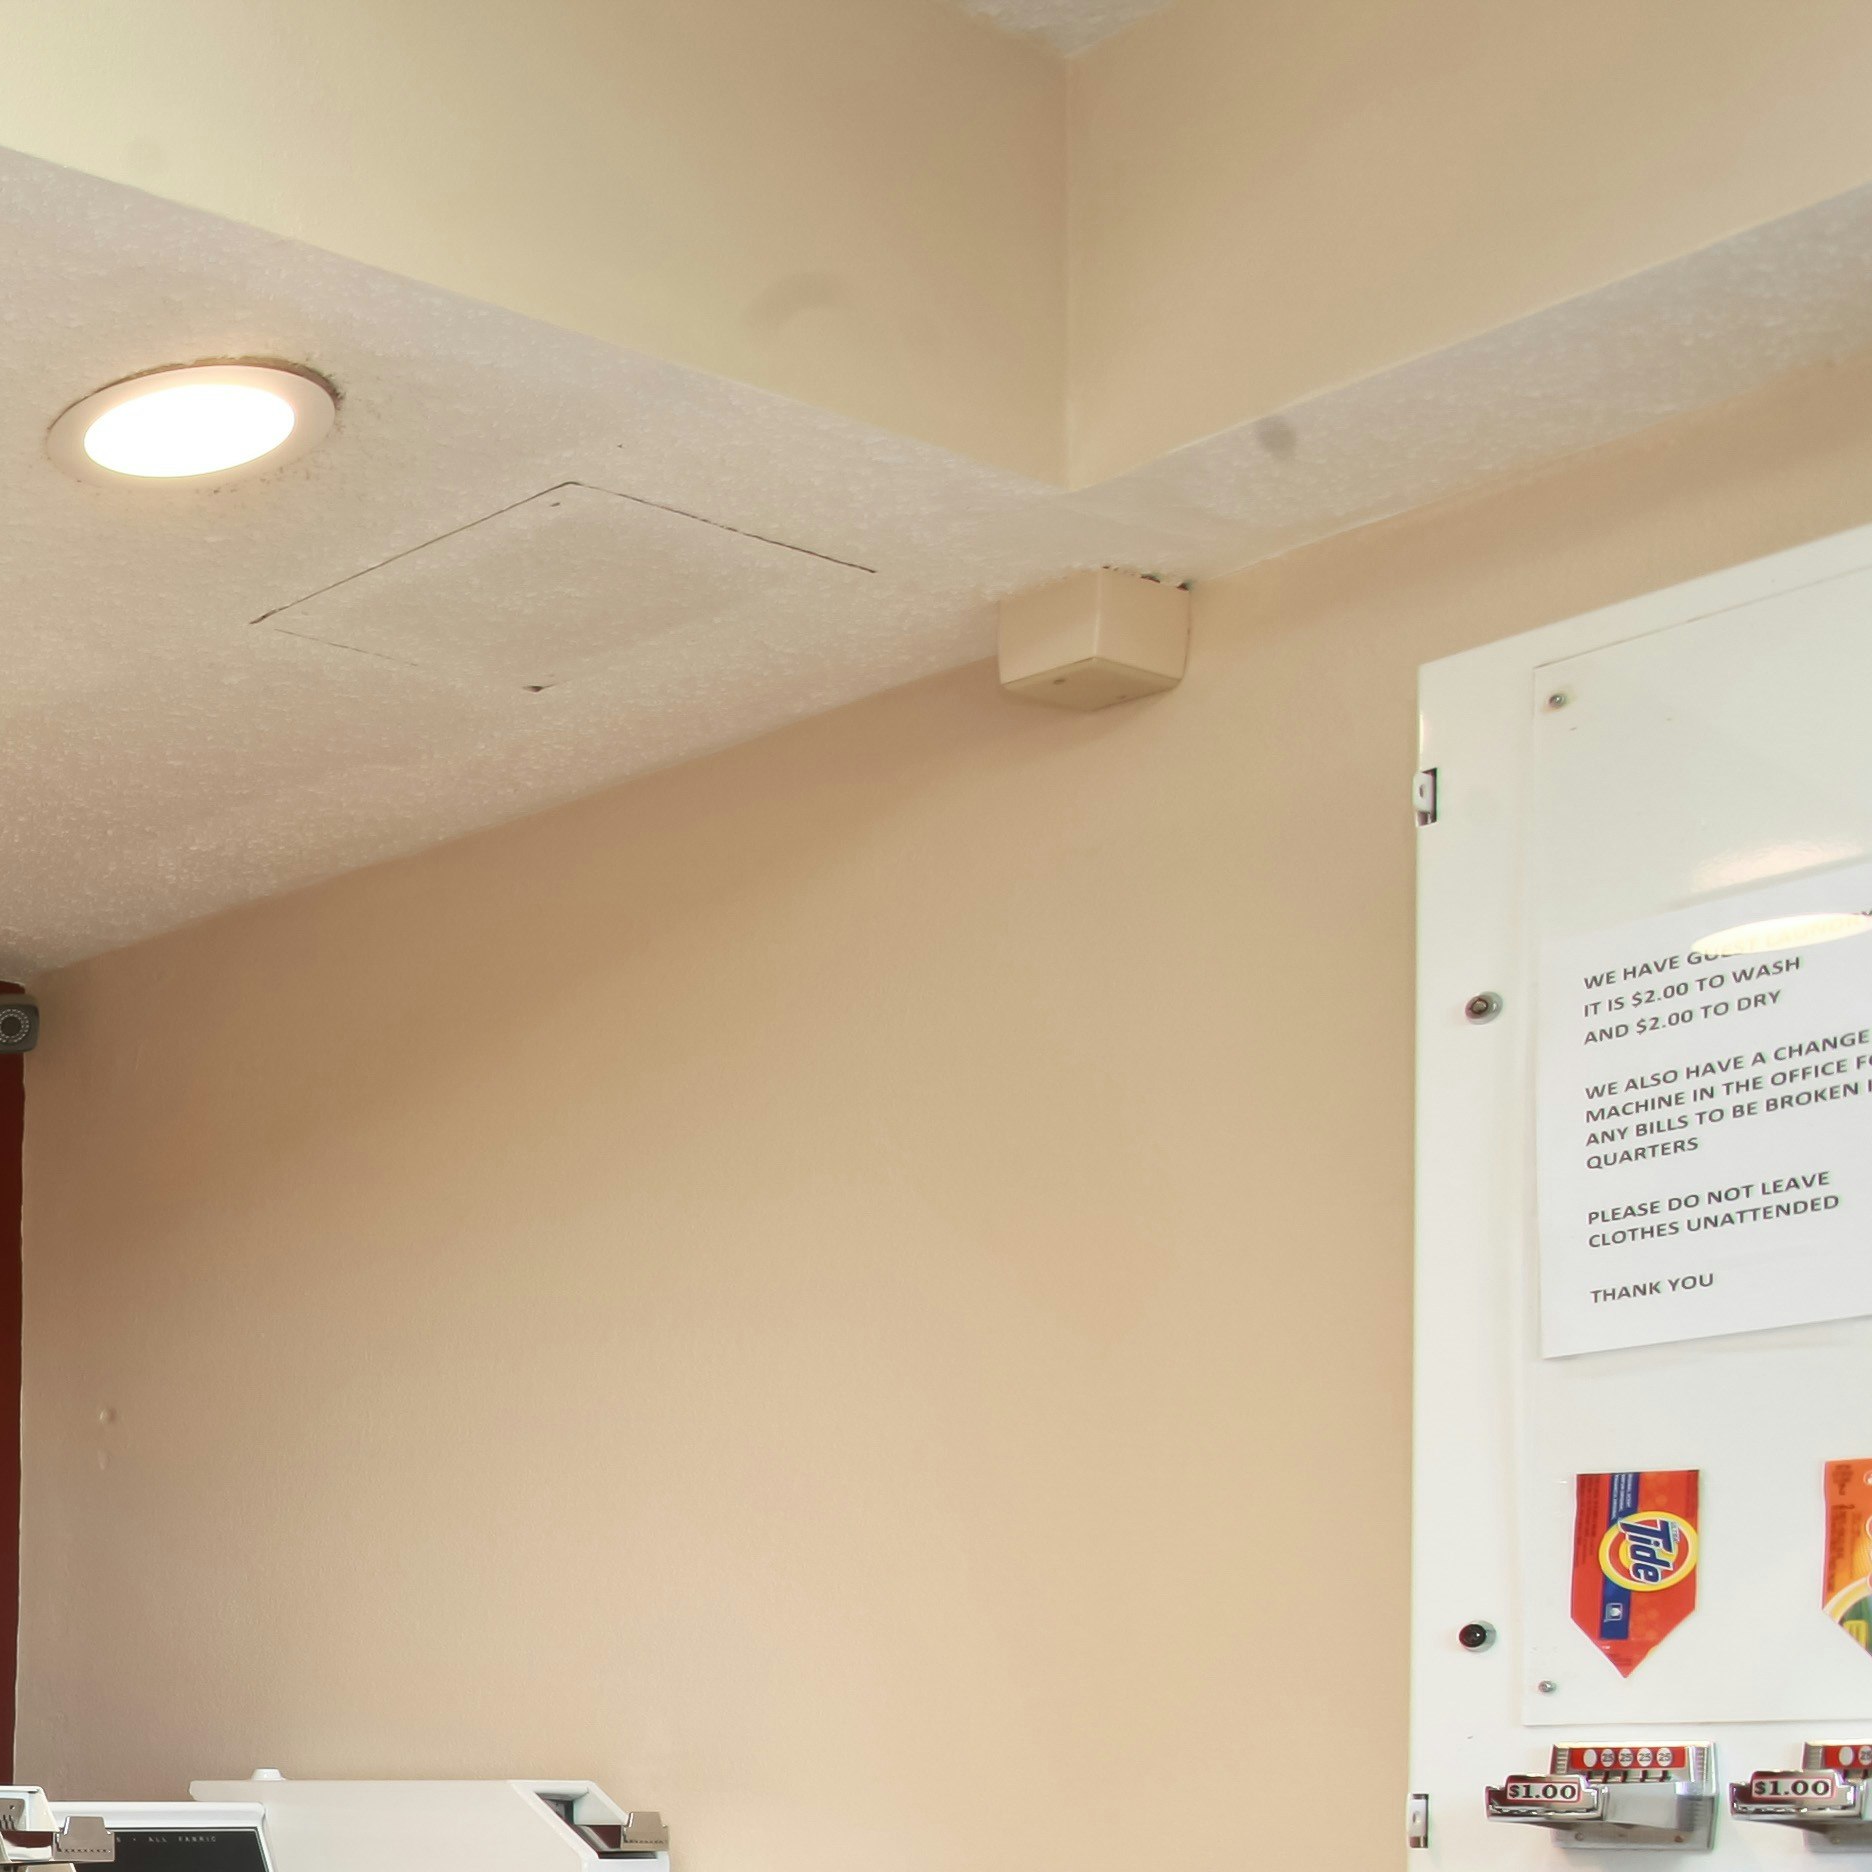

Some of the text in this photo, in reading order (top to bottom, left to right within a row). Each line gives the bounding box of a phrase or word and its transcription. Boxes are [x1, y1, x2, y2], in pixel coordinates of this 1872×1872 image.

[1584, 971, 1616, 989] WE
[1623, 955, 1680, 981] HAVE
[1584, 957, 1800, 1017] IT IS $2.00 TO WASH
[1584, 990, 1781, 1045] AND $2.00 TO DRY
[1585, 1029, 1870, 1100] WE ALSO HAVE A CHANGE
[1585, 1091, 1685, 1123] MACHINE
[1692, 1086, 1715, 1103] IN
[1722, 1076, 1764, 1096] THE
[1770, 1059, 1847, 1086] OFFICE
[1586, 1082, 1859, 1147] ANY BILLS TO BE BROKEN
[1586, 1137, 1699, 1169] QUARTERS
[1588, 1171, 1830, 1225] PLEASE DO NOT LEAVE
[1588, 1195, 1840, 1248] CLOTHES UNATTENDED
[1590, 1273, 1714, 1303] THANK YOU
[1619, 1517, 1674, 1584] Tide
[1602, 1753, 1614, 1762] 25
[1619, 1753, 1632, 1762] 25
[1639, 1753, 1651, 1762] 25
[1658, 1753, 1671, 1762] 25
[1508, 1784, 1577, 1799] $1.00
[1754, 1780, 1829, 1795] $1.00
